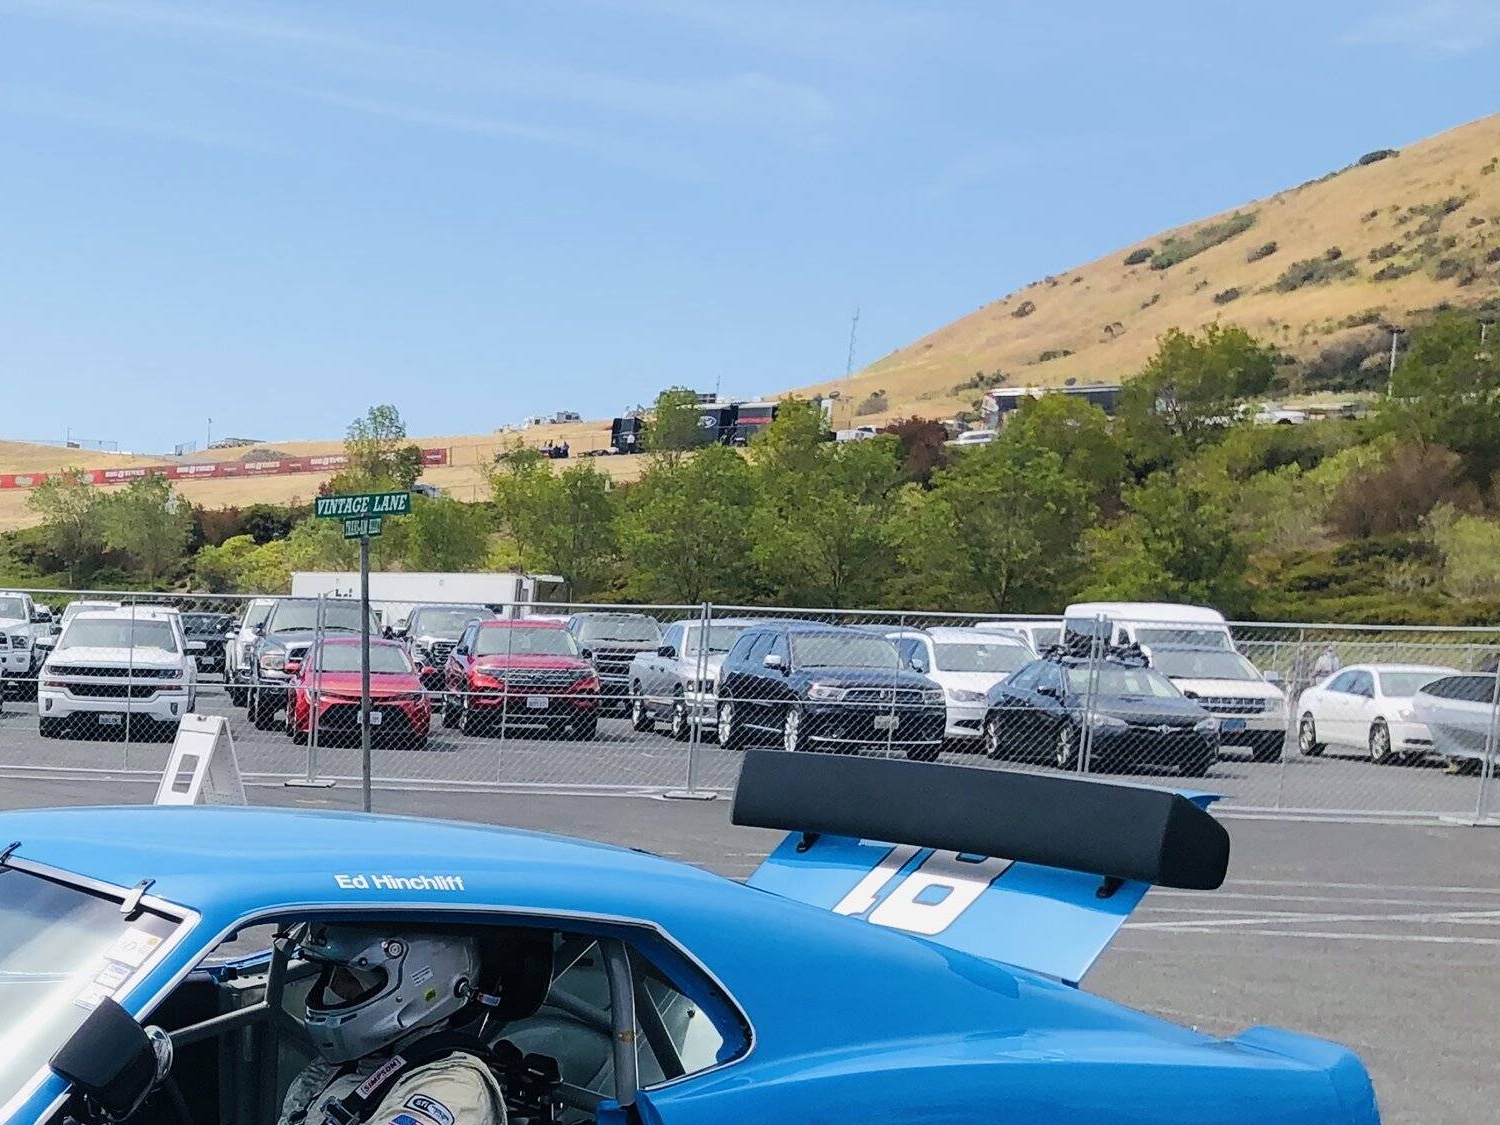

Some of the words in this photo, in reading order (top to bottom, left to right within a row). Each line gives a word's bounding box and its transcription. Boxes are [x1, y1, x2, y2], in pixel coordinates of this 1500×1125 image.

[316, 496, 370, 515] VINTAGE
[373, 494, 408, 512] LANE
[334, 874, 369, 889] Ed
[371, 874, 465, 891] Hinchliff
[363, 1060, 398, 1094] SIMPSON
